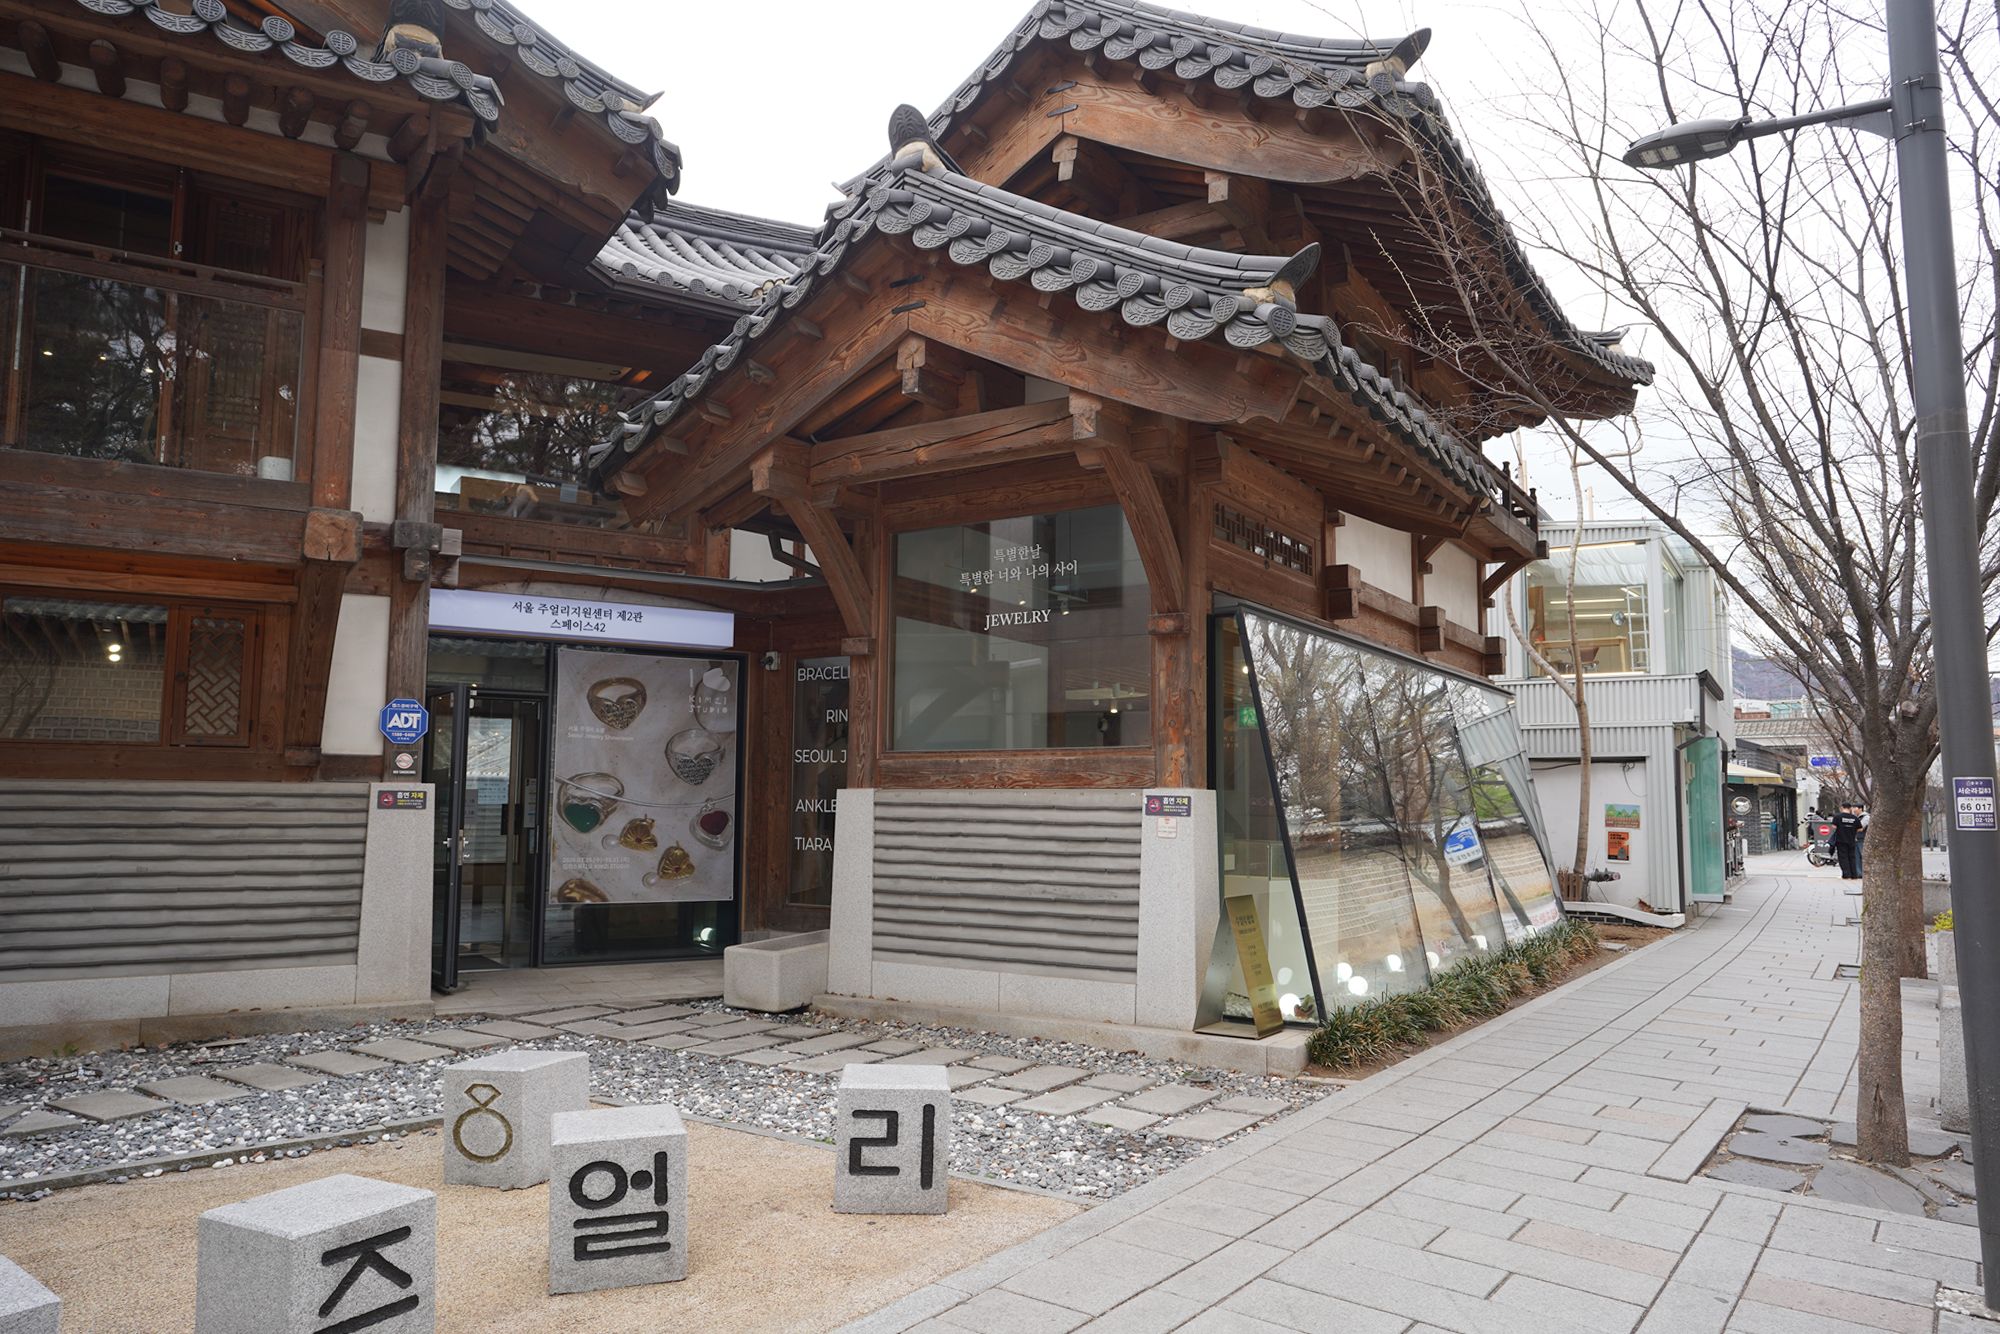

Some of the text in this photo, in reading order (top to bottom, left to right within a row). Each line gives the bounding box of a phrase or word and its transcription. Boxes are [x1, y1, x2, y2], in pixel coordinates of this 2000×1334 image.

[994, 543, 1042, 562] 특별한날
[960, 559, 1077, 587] 특별한 너와 나의 사이
[512, 601, 643, 623] 서울 주얼리지원센터 제2관
[984, 608, 1051, 631] JEWELRY
[550, 619, 606, 632] 스페이스42
[797, 665, 850, 682] BRACEL
[387, 712, 421, 729] ADT
[826, 709, 848, 723] RIN
[794, 749, 838, 763] SEOUL
[397, 791, 410, 799] 흡연
[1960, 803, 1992, 811] 66 017
[795, 837, 832, 852] TIARA
[848, 1103, 934, 1191] 리
